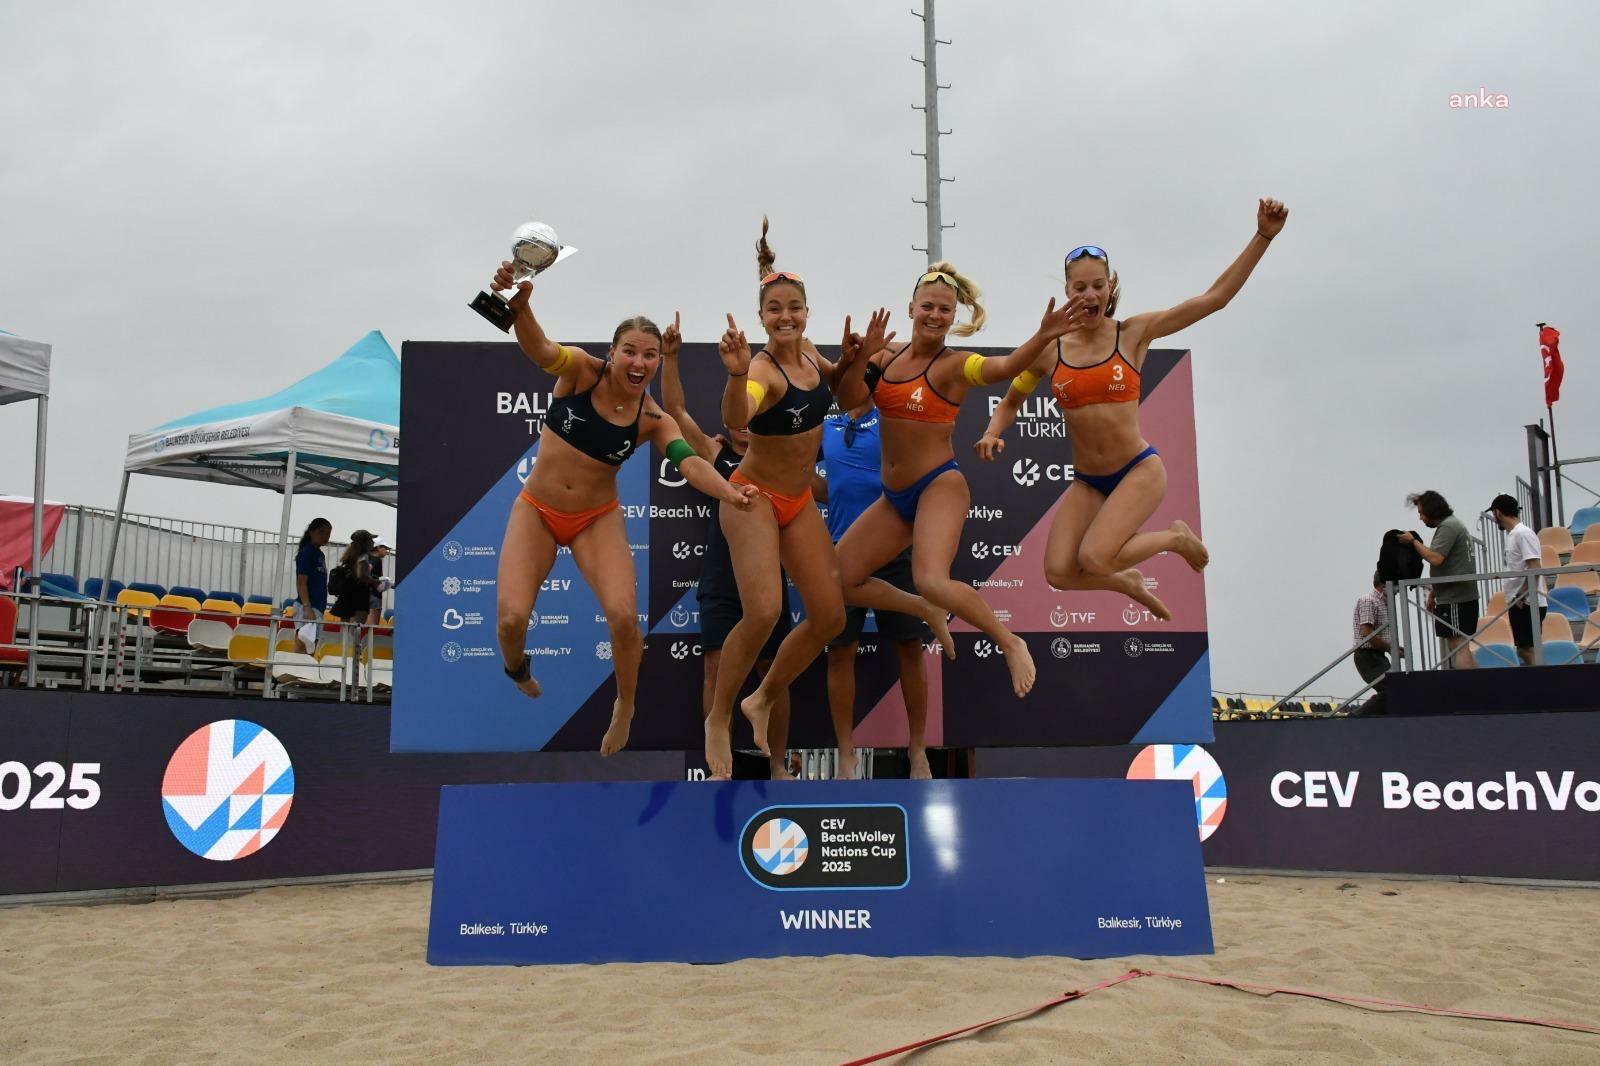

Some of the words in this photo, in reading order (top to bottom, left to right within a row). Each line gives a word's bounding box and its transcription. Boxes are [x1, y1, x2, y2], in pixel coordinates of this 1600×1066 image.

[1112, 364, 1123, 381] 3
[1108, 383, 1126, 391] NED
[911, 386, 923, 402] 4
[906, 402, 924, 412] NED
[616, 440, 630, 456] 2
[650, 505, 693, 518] Beach
[992, 545, 1023, 556] CEV
[541, 579, 571, 591] CEV
[973, 580, 1024, 588] EuroVolley.TV
[1070, 612, 1095, 623] TVF
[1270, 770, 1360, 808] CEV
[820, 818, 846, 829] CEV
[821, 831, 896, 844] BeachVolley
[821, 846, 868, 857] Nations
[871, 846, 897, 858] Cup
[821, 861, 852, 872] 2025
[780, 909, 872, 929] WINNER
[1097, 917, 1142, 929] Balıkesir,
[1144, 916, 1182, 930] Türkiye
[460, 923, 505, 936] Balıkesir,
[509, 922, 548, 936] Türkiye
